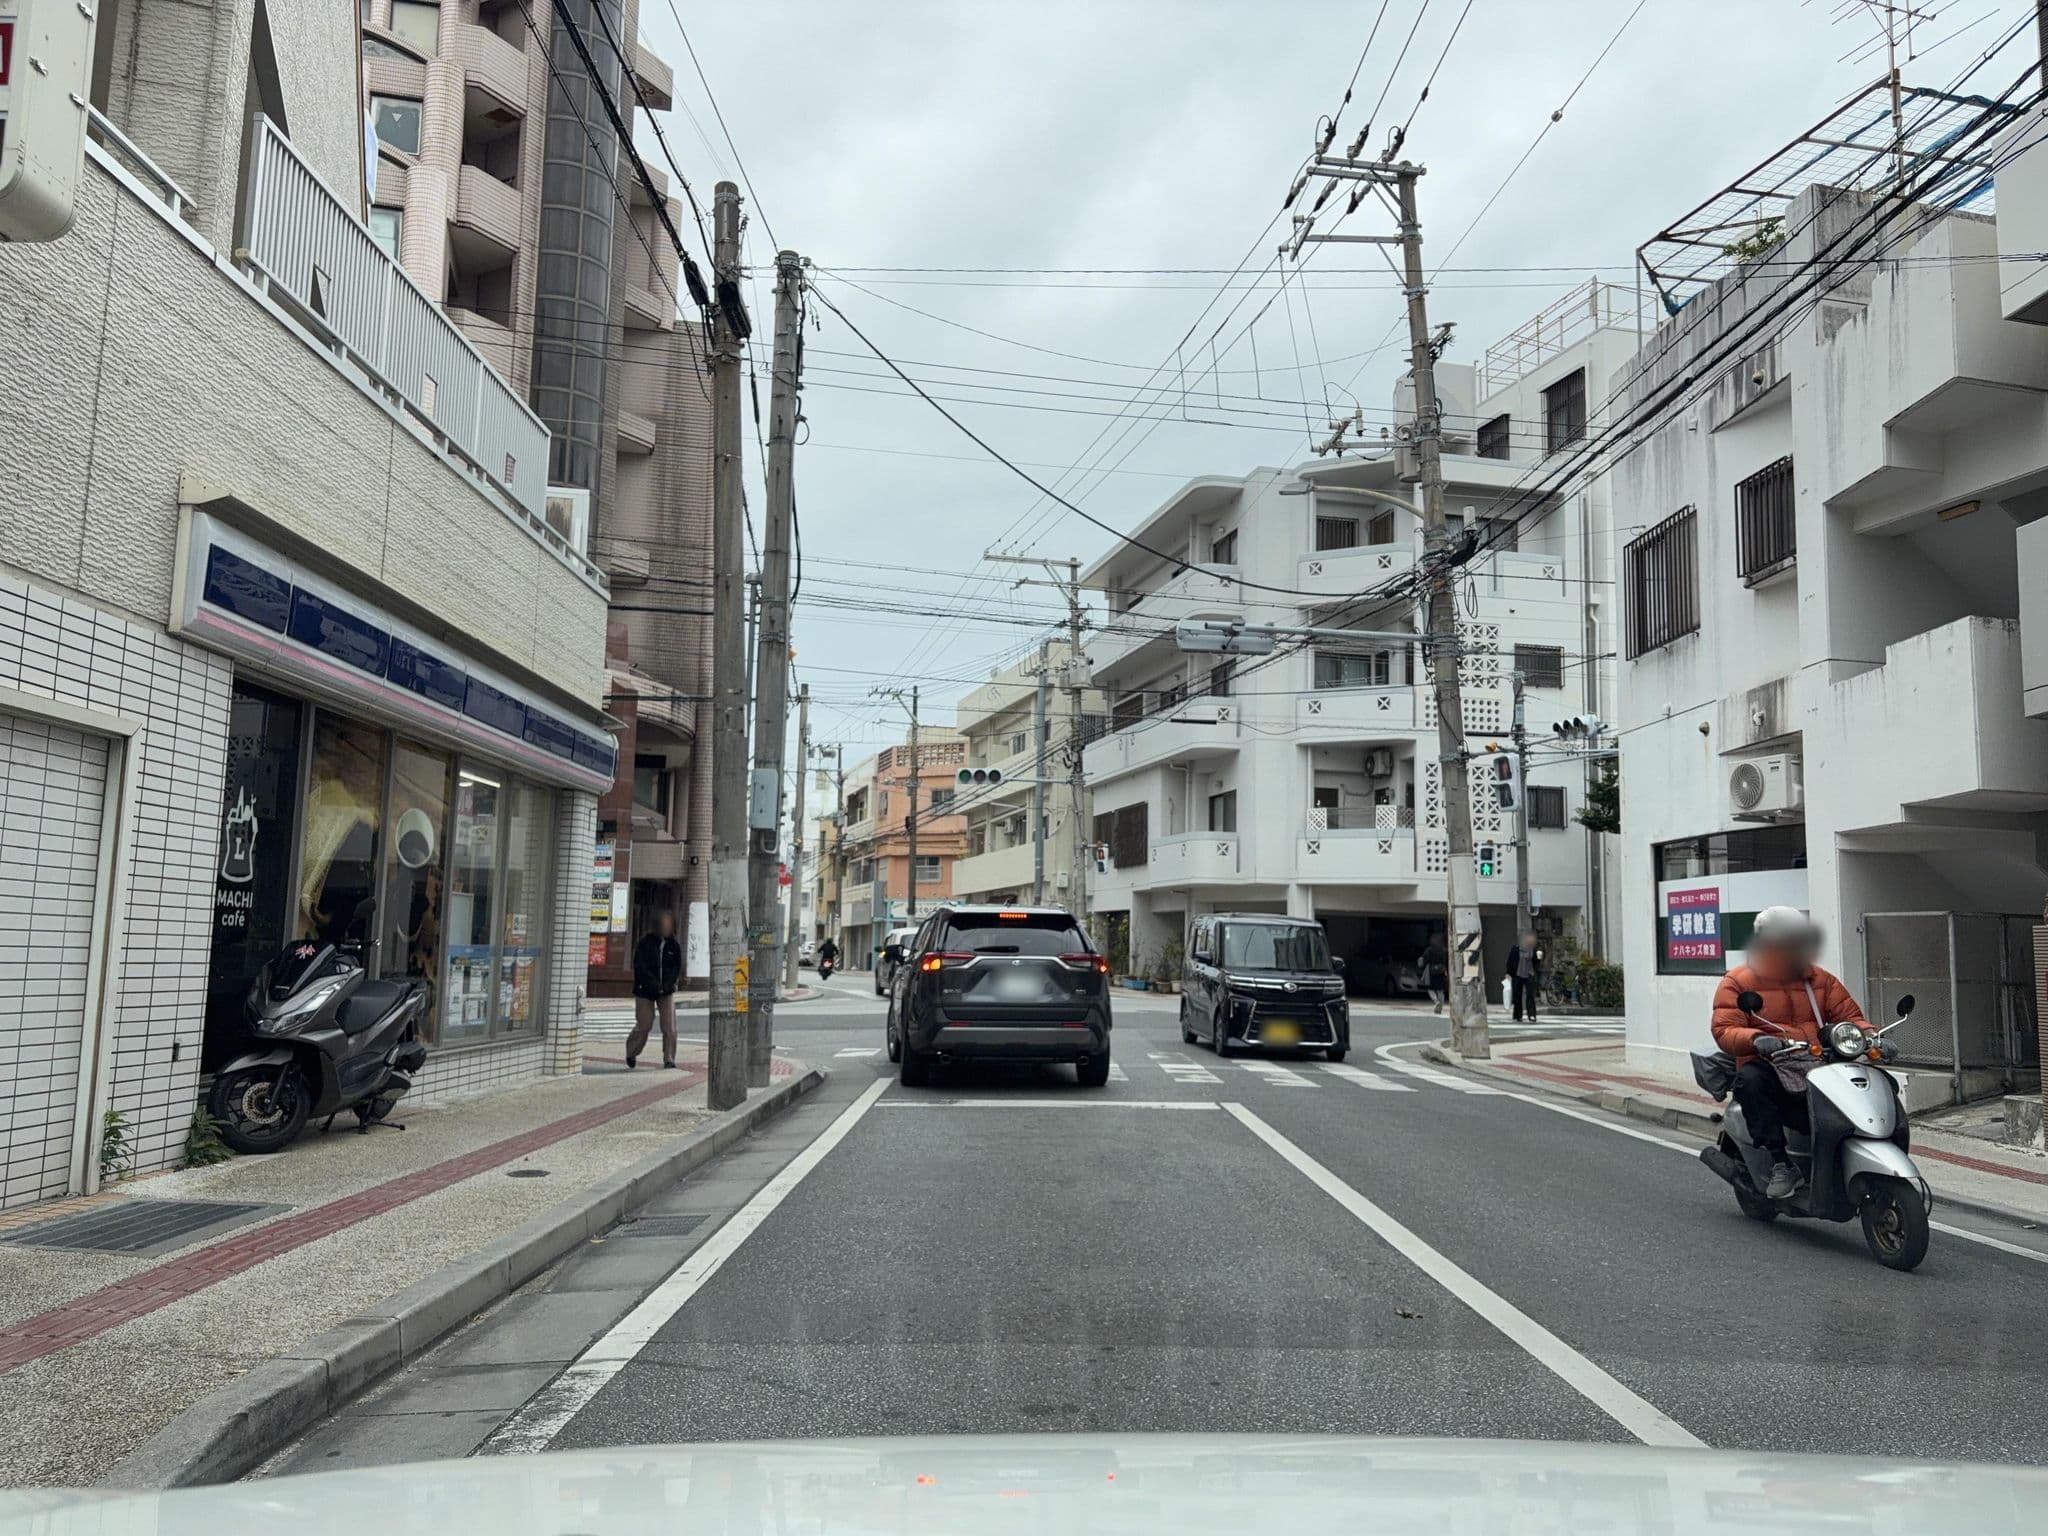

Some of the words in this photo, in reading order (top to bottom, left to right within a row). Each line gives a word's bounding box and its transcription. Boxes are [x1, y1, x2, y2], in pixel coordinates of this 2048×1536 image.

[217, 889, 254, 908] MACHI
[221, 910, 246, 926] café
[1672, 911, 1716, 936] 学研教室
